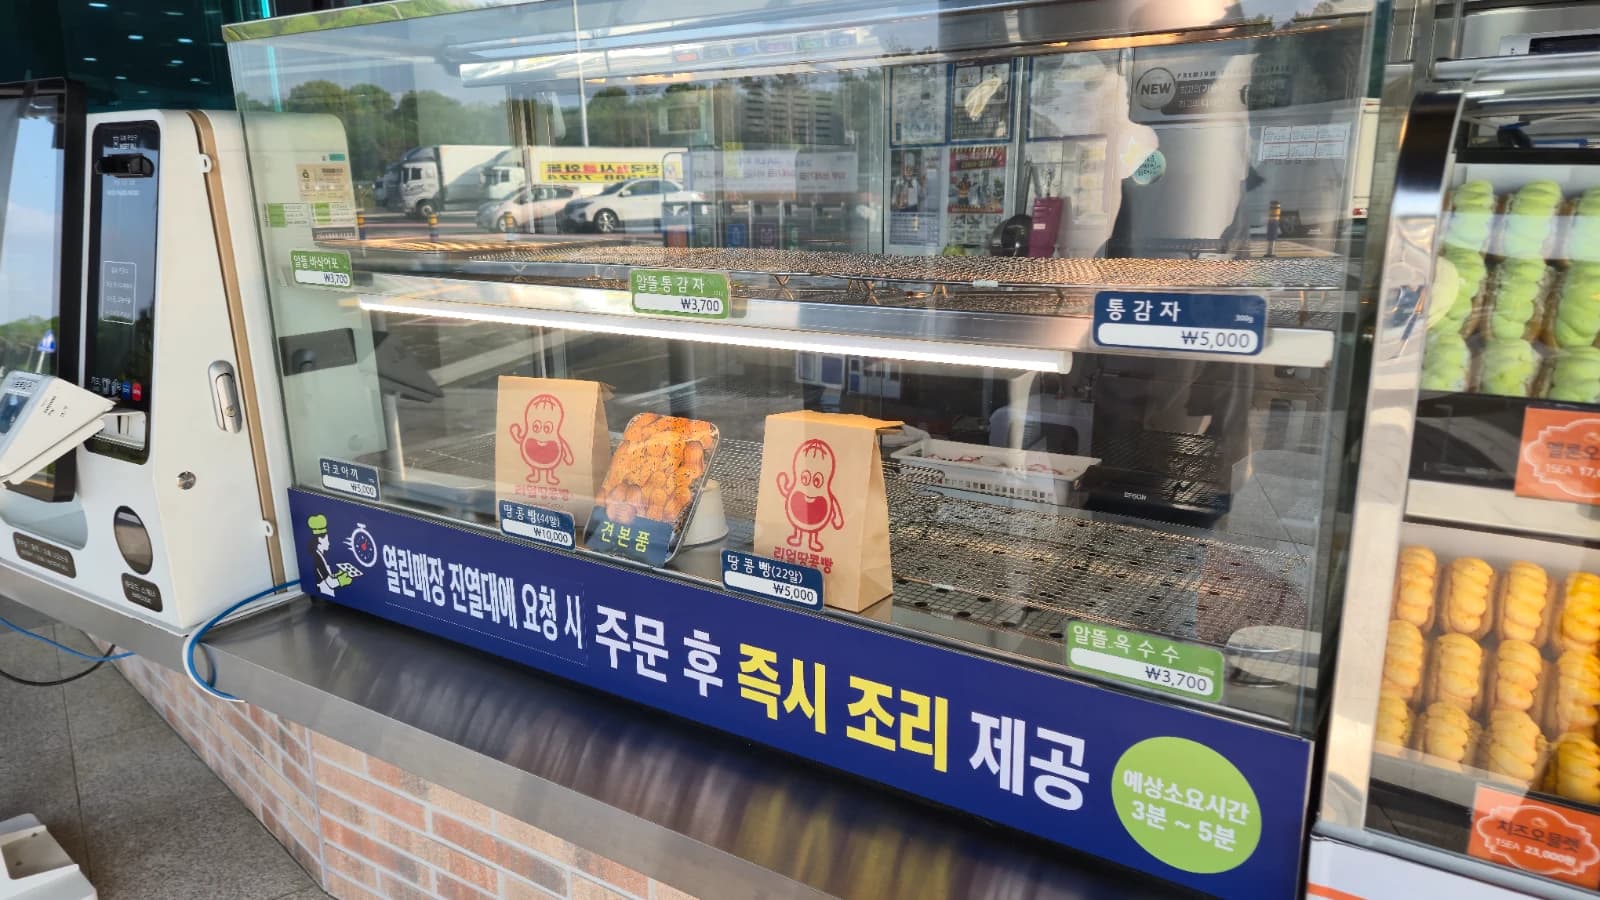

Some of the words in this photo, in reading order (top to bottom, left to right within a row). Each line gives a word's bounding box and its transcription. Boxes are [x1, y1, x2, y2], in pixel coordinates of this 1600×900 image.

[1141, 82, 1172, 95] NEW
[680, 297, 720, 312] ₩3,700
[1181, 330, 1250, 349] ₩5,000
[533, 527, 569, 544] ₩10,000
[773, 582, 814, 602] ₩5,000
[382, 544, 446, 607] 열린매장
[448, 561, 518, 629] 진열대에
[521, 583, 559, 642] 요청
[564, 594, 584, 650] 시
[595, 604, 669, 683] 주문
[683, 628, 724, 698] 후
[736, 642, 828, 735] 즉시
[846, 674, 950, 774] 조리
[969, 710, 1091, 812] 제공
[1144, 665, 1207, 692] ₩3,700
[1123, 769, 1251, 826] 예상소요시간
[1131, 799, 1168, 831] 3분
[1197, 820, 1237, 852] 5분
